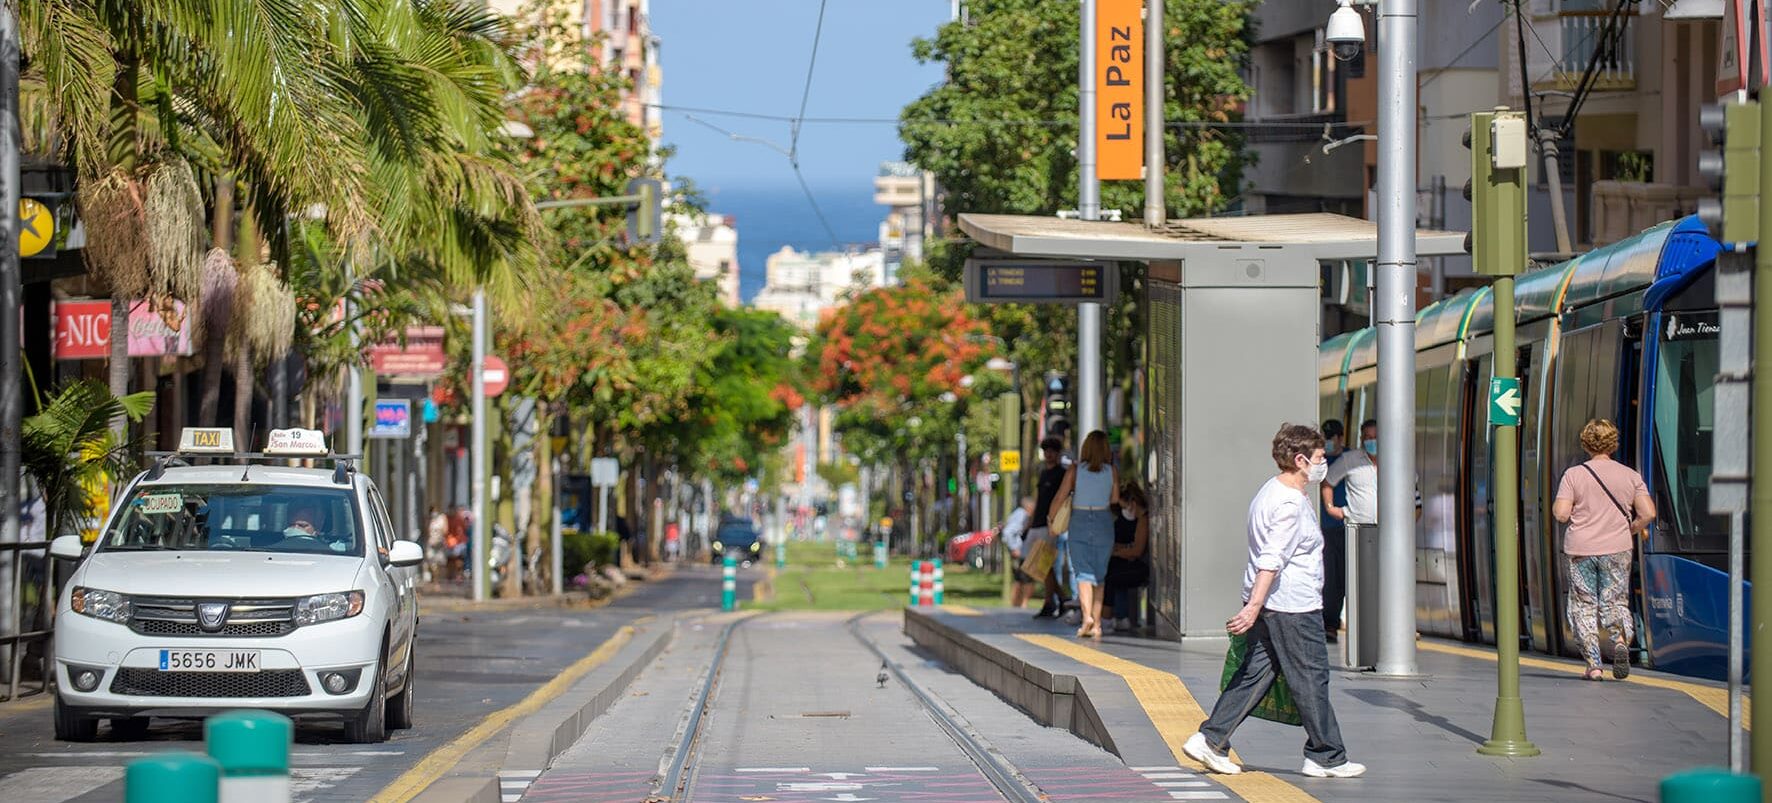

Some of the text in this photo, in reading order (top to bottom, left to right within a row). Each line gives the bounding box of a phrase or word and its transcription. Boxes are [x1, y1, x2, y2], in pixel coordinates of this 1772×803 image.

[1106, 26, 1131, 140] La Paz
[52, 313, 109, 347] -NIC
[194, 431, 221, 446] TAXI
[291, 431, 301, 439] 19
[273, 440, 288, 449] San
[171, 652, 257, 669] 5656 JMK
